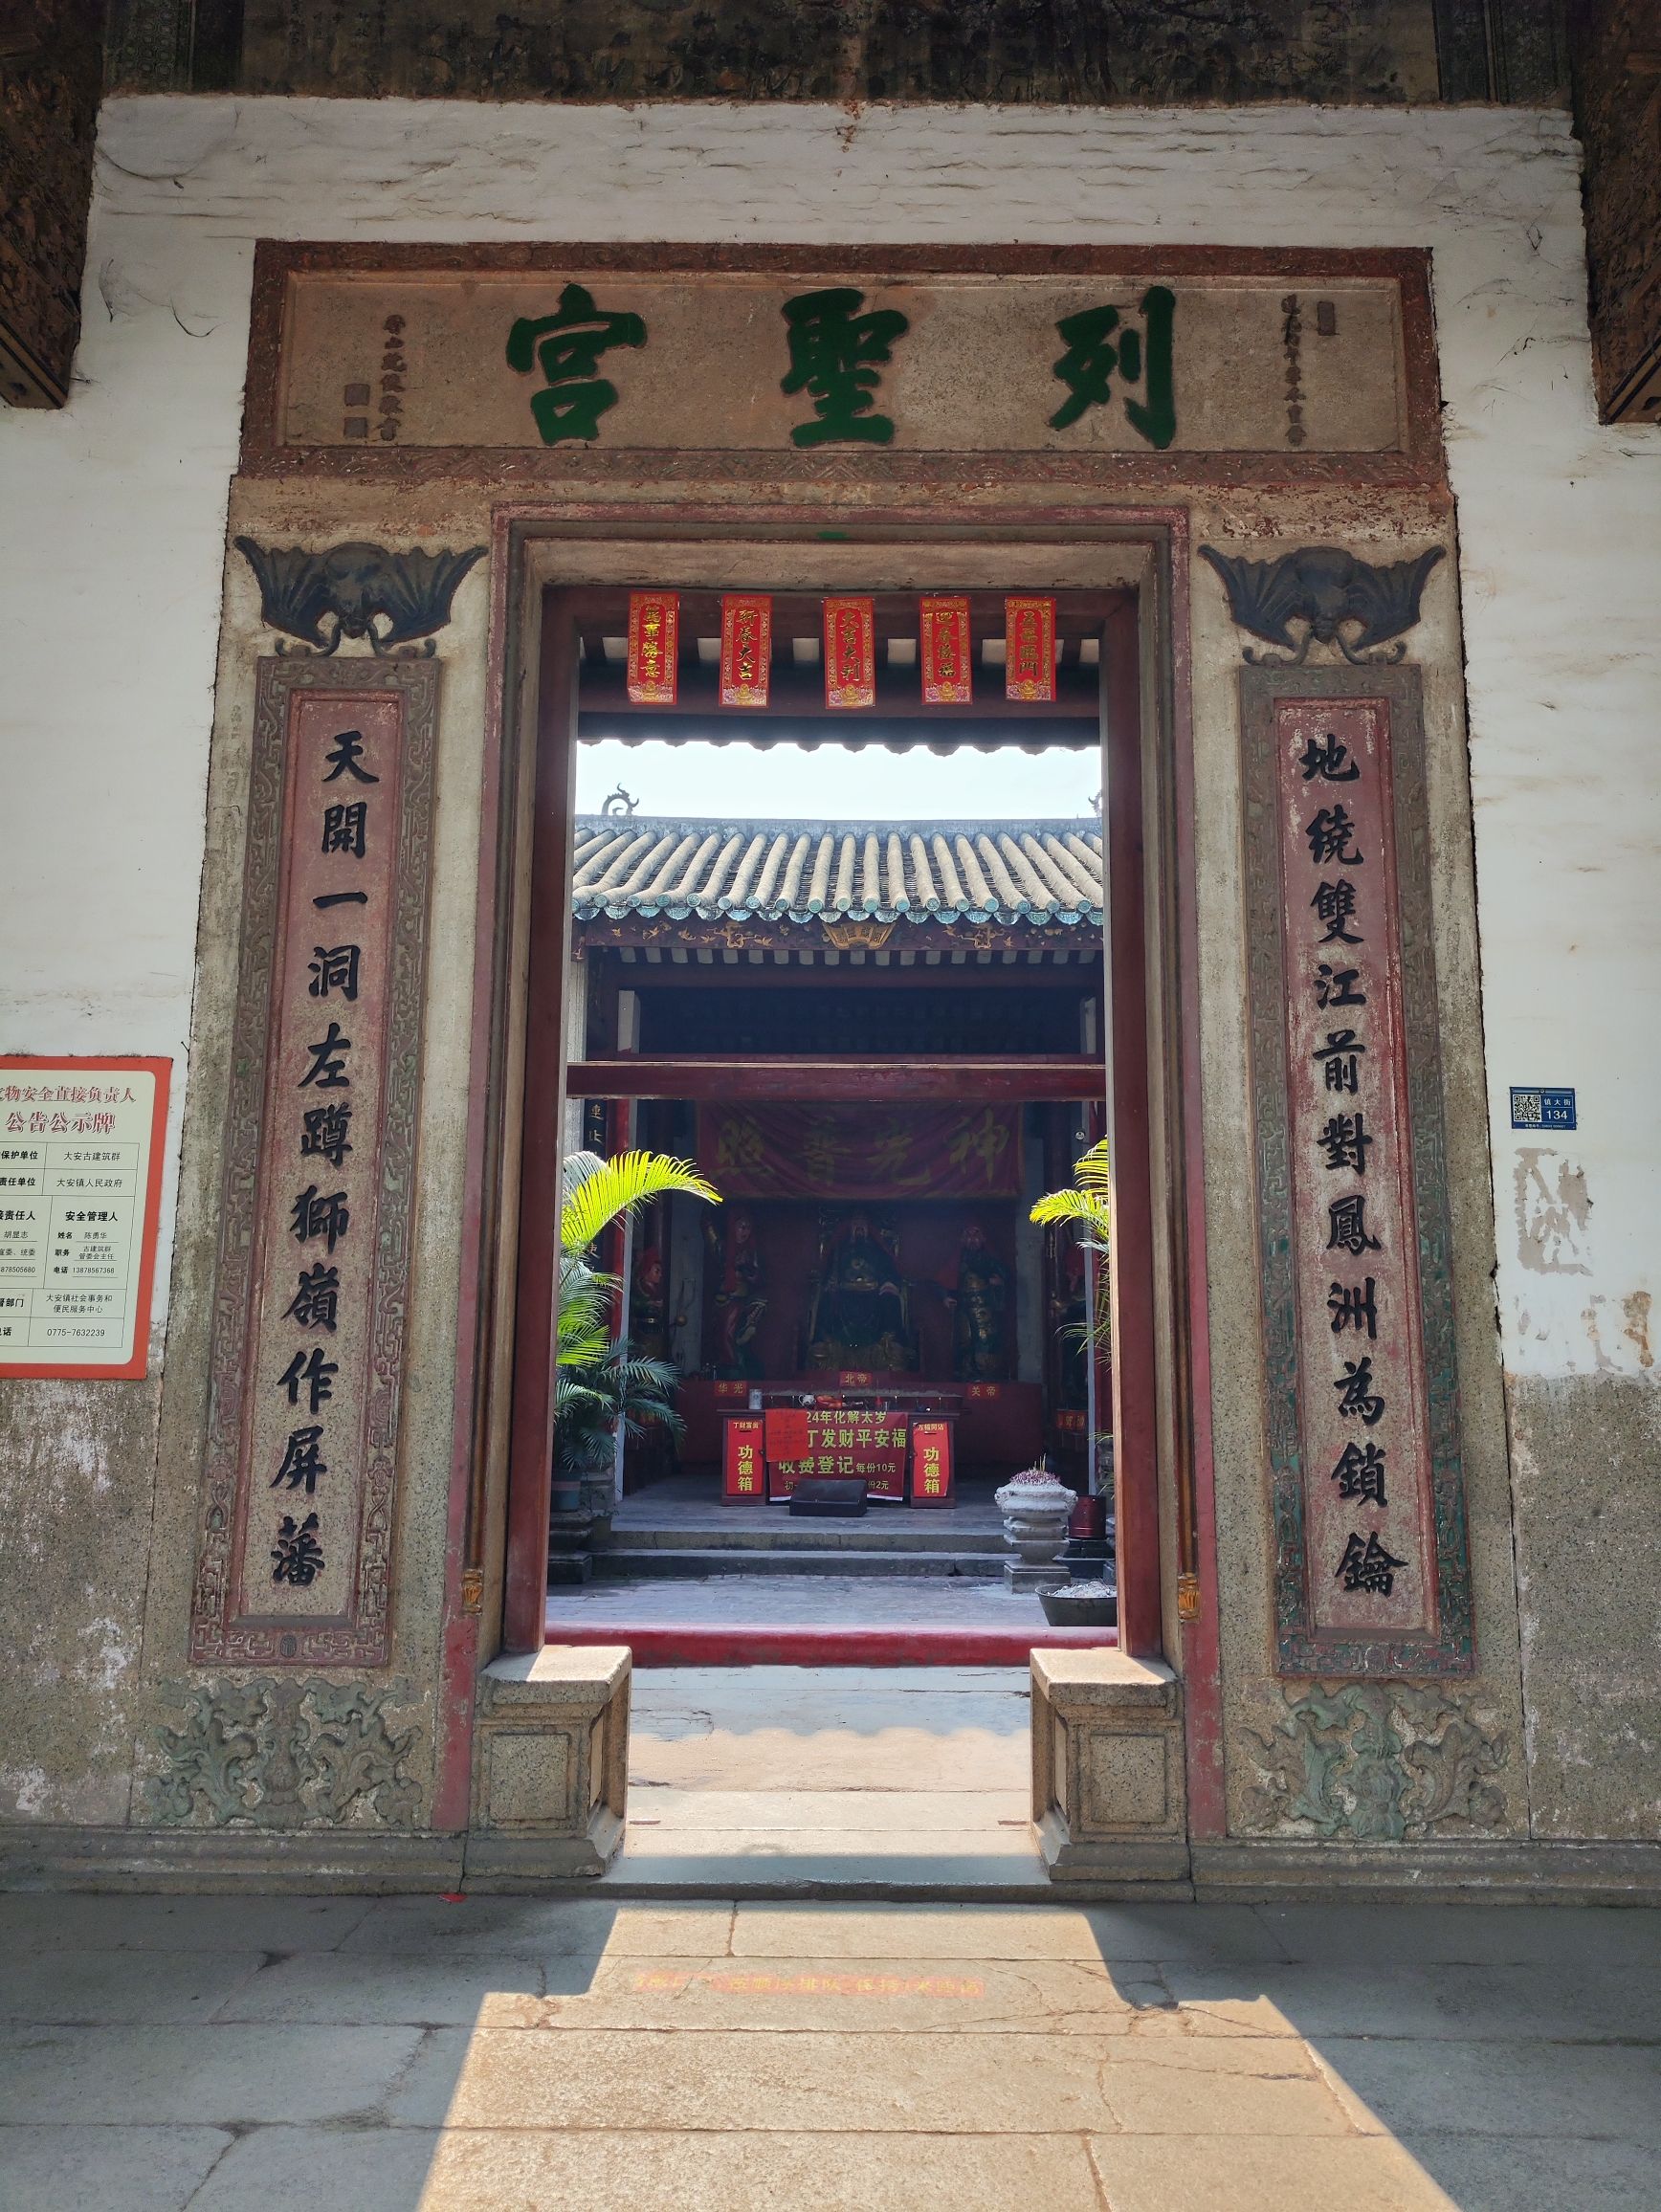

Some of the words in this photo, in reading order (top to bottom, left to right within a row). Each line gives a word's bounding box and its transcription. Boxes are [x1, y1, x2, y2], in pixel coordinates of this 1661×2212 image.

[506, 282, 1176, 451] 列聖宮
[840, 611, 860, 681] 大吉大利
[1546, 1110, 1568, 1119] 134
[6, 1111, 116, 1134] 公告公示牌
[63, 1151, 121, 1161] 大安古建筑群
[55, 1178, 122, 1187] 大安镇人民政府
[0, 1209, 36, 1221] 责任人
[65, 1210, 119, 1222] 安全管理人
[57, 1231, 73, 1240] 姓名
[55, 1249, 70, 1257] 职务
[54, 1266, 69, 1274] 电话
[46, 1293, 113, 1303] 大安镇社会事务和
[53, 1304, 103, 1314] 便民服务中心
[47, 1328, 105, 1337] 0775-7632239
[738, 1445, 754, 1492] 功德箱
[923, 1447, 941, 1493] 功德箱
